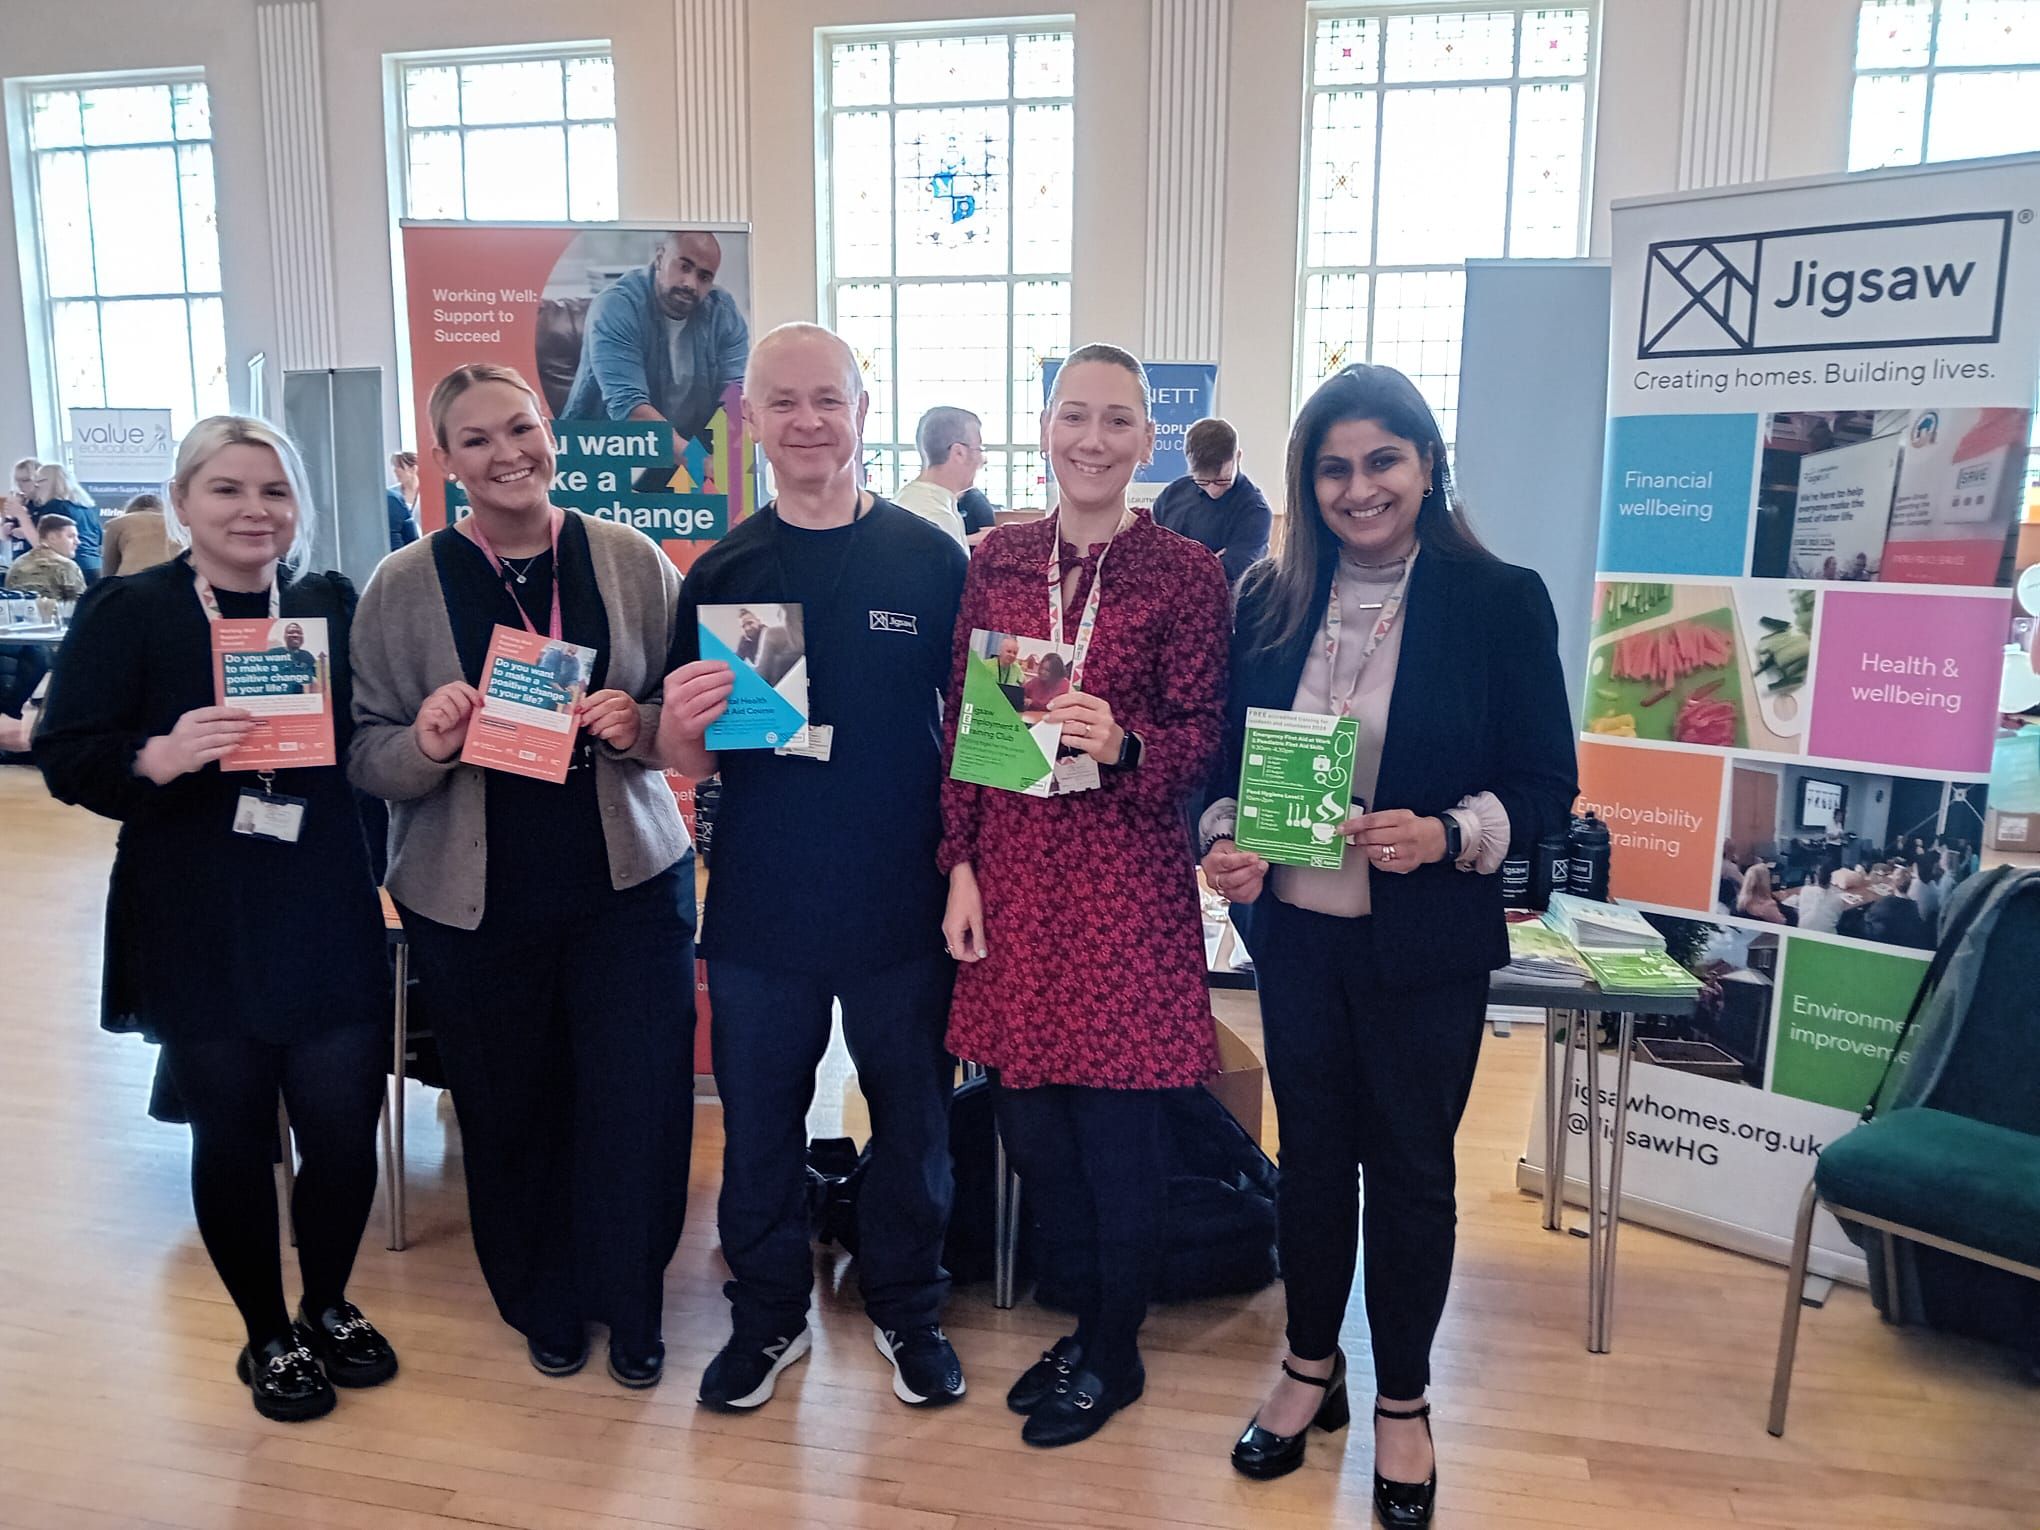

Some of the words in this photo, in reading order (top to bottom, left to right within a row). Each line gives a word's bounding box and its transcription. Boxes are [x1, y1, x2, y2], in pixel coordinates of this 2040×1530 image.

[432, 288, 496, 304] Working
[499, 288, 538, 303] Well:
[1774, 259, 1976, 318] Jigsaw
[433, 309, 495, 325] Support
[498, 310, 514, 323] to
[434, 329, 500, 343] Succeed
[1633, 368, 1729, 393] Creating
[1735, 366, 1817, 387] homes.
[1825, 361, 1926, 386] Building
[1932, 358, 1996, 380] lives.
[78, 423, 144, 444] value
[577, 431, 660, 457] want
[597, 471, 617, 491] a
[1624, 470, 1713, 489] Financial
[1618, 499, 1713, 521] wellbeing
[224, 654, 242, 663] Do
[242, 655, 264, 664] you
[264, 653, 292, 662] want
[225, 664, 238, 673] to
[239, 664, 270, 673] make
[496, 657, 510, 668] Do
[510, 663, 529, 673] you
[531, 668, 555, 680] want
[1861, 652, 1936, 677] Health
[1942, 658, 1959, 678] &
[226, 674, 268, 684] positive
[270, 674, 310, 683] change
[493, 668, 504, 676] to
[505, 672, 532, 684] make
[226, 685, 238, 694] in
[239, 686, 264, 695] your
[488, 686, 498, 694] in
[498, 690, 522, 700] your
[490, 678, 528, 692] positive
[530, 687, 565, 701] change
[1851, 682, 1962, 712] wellbeing
[1576, 795, 1703, 832] Employability
[1609, 828, 1681, 858] training
